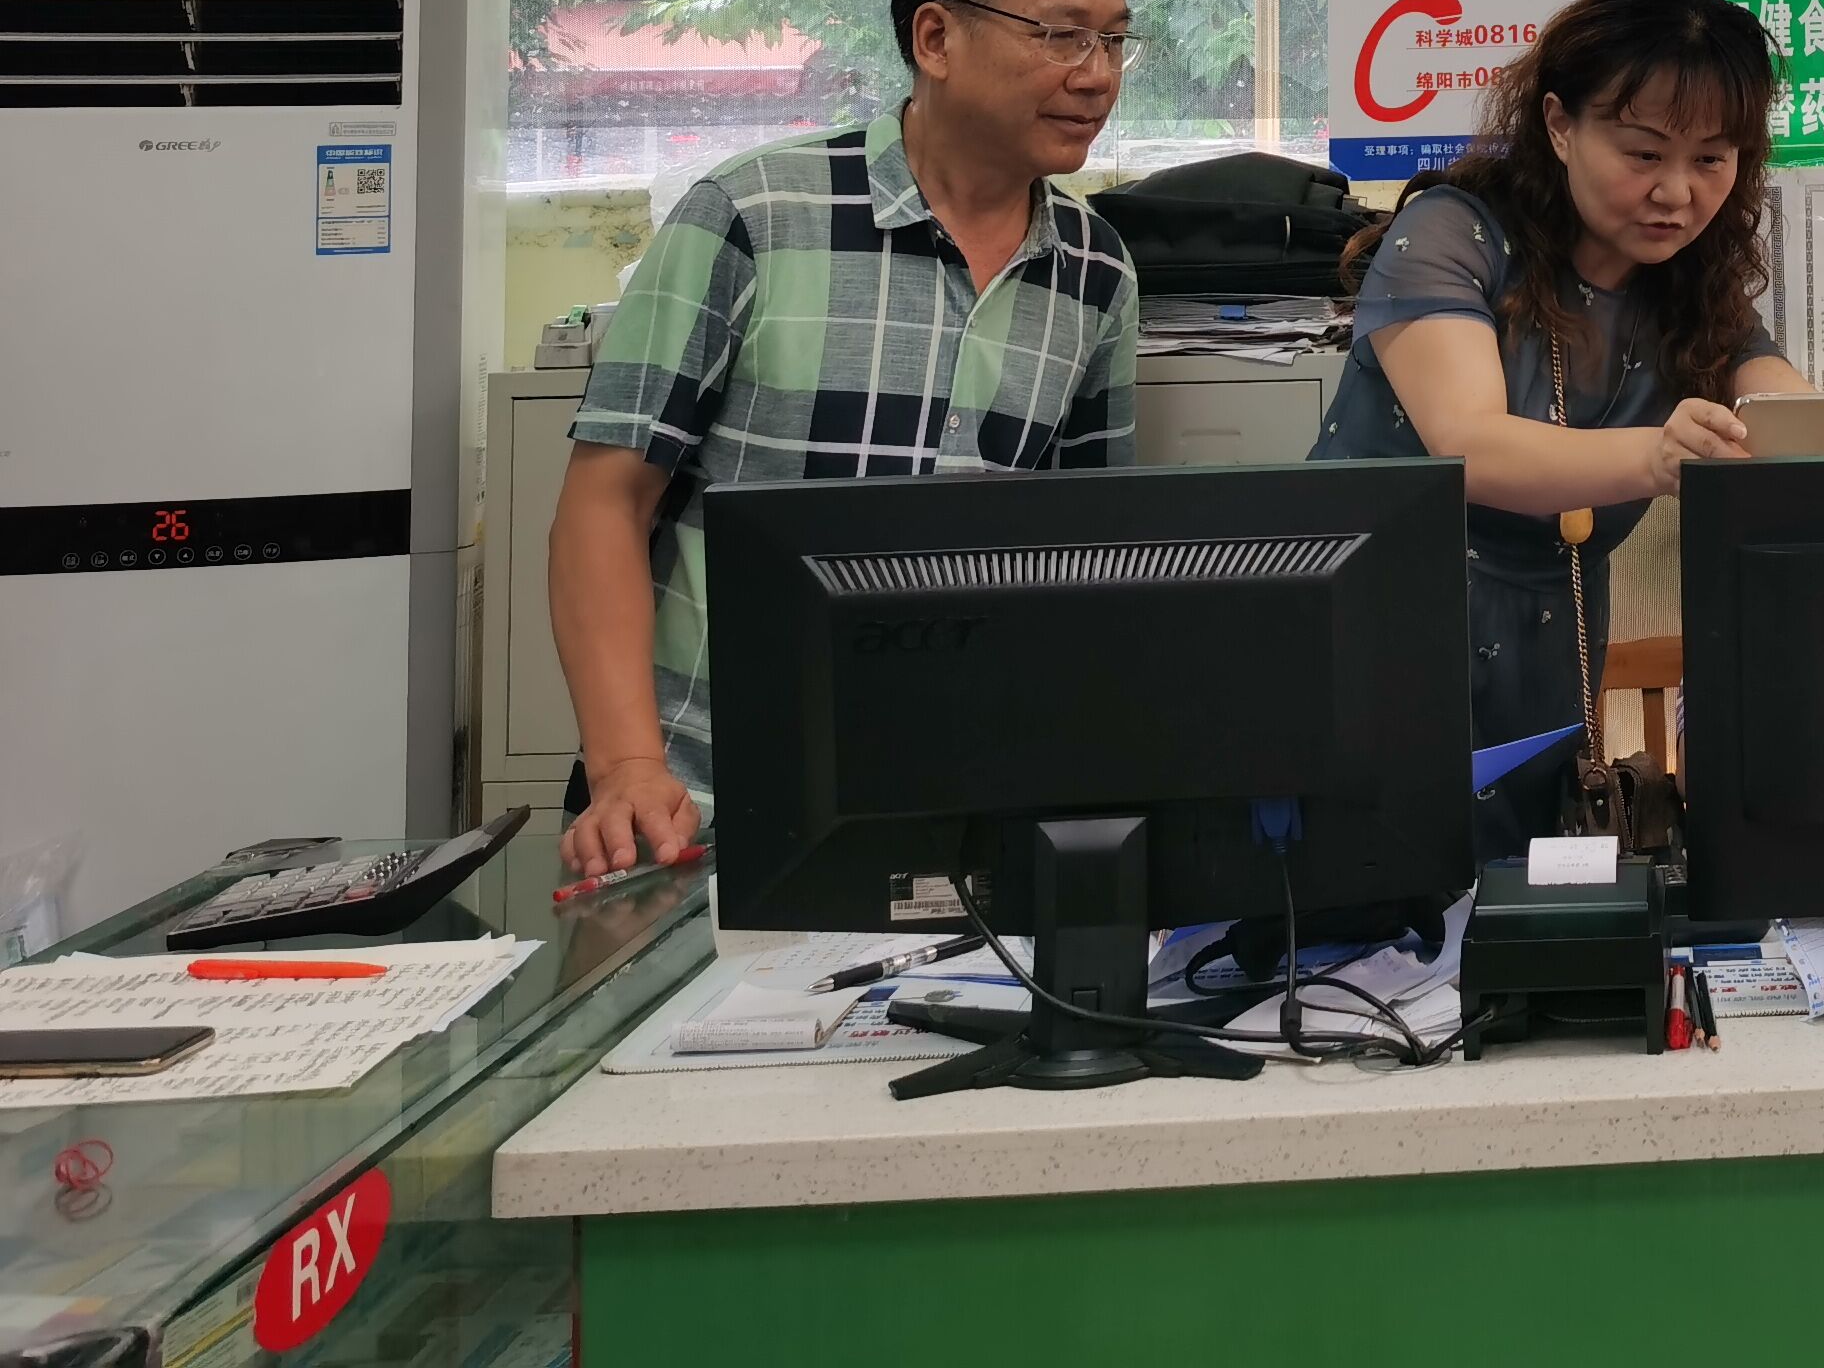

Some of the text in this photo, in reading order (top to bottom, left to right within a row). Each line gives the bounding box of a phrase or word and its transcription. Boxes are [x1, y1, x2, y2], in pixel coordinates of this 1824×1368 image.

[1415, 23, 1537, 48] 科学城0816
[156, 141, 198, 151] GREE
[152, 510, 190, 541] 26
[854, 616, 989, 654] acer
[292, 1192, 357, 1322] RX
